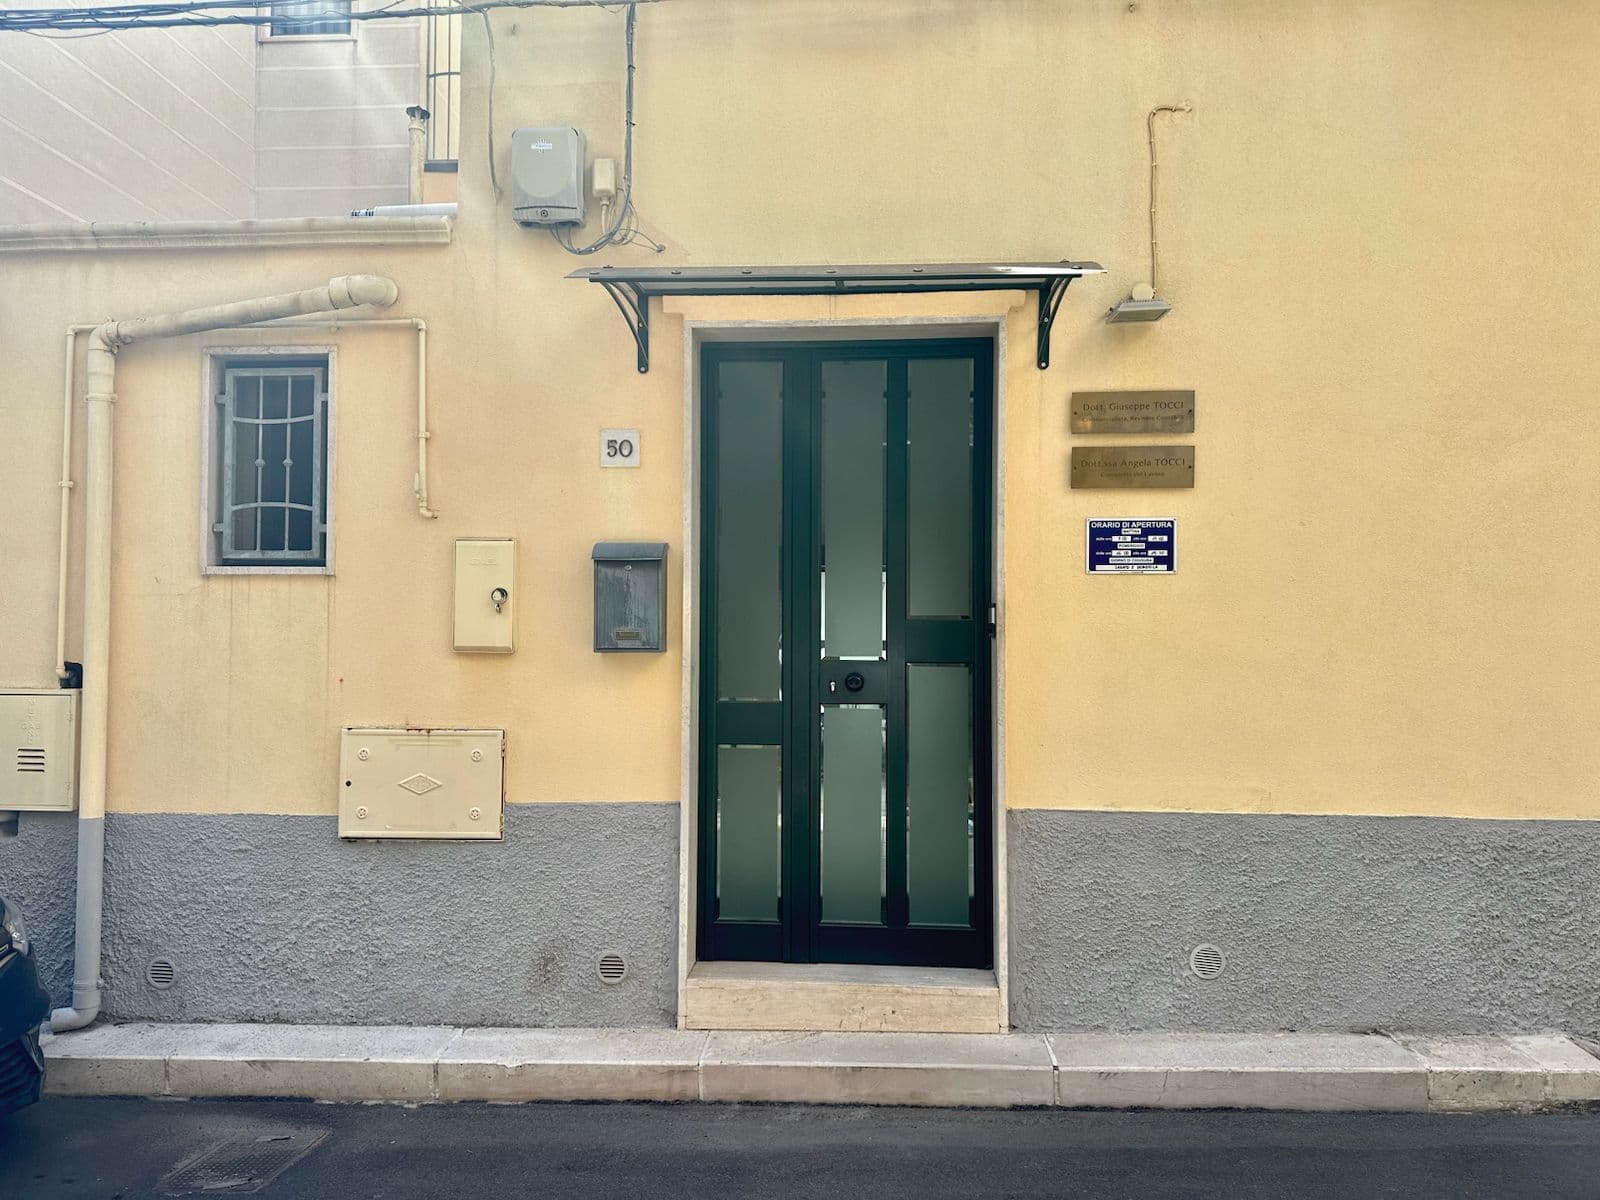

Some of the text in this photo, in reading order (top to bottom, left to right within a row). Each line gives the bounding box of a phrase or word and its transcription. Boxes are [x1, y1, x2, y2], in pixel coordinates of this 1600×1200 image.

[1109, 402, 1150, 412] Giuseppe
[1154, 401, 1184, 409] TOCCI
[607, 439, 633, 457] 50
[1121, 458, 1152, 469] Angela
[1154, 458, 1185, 466] TOCCI
